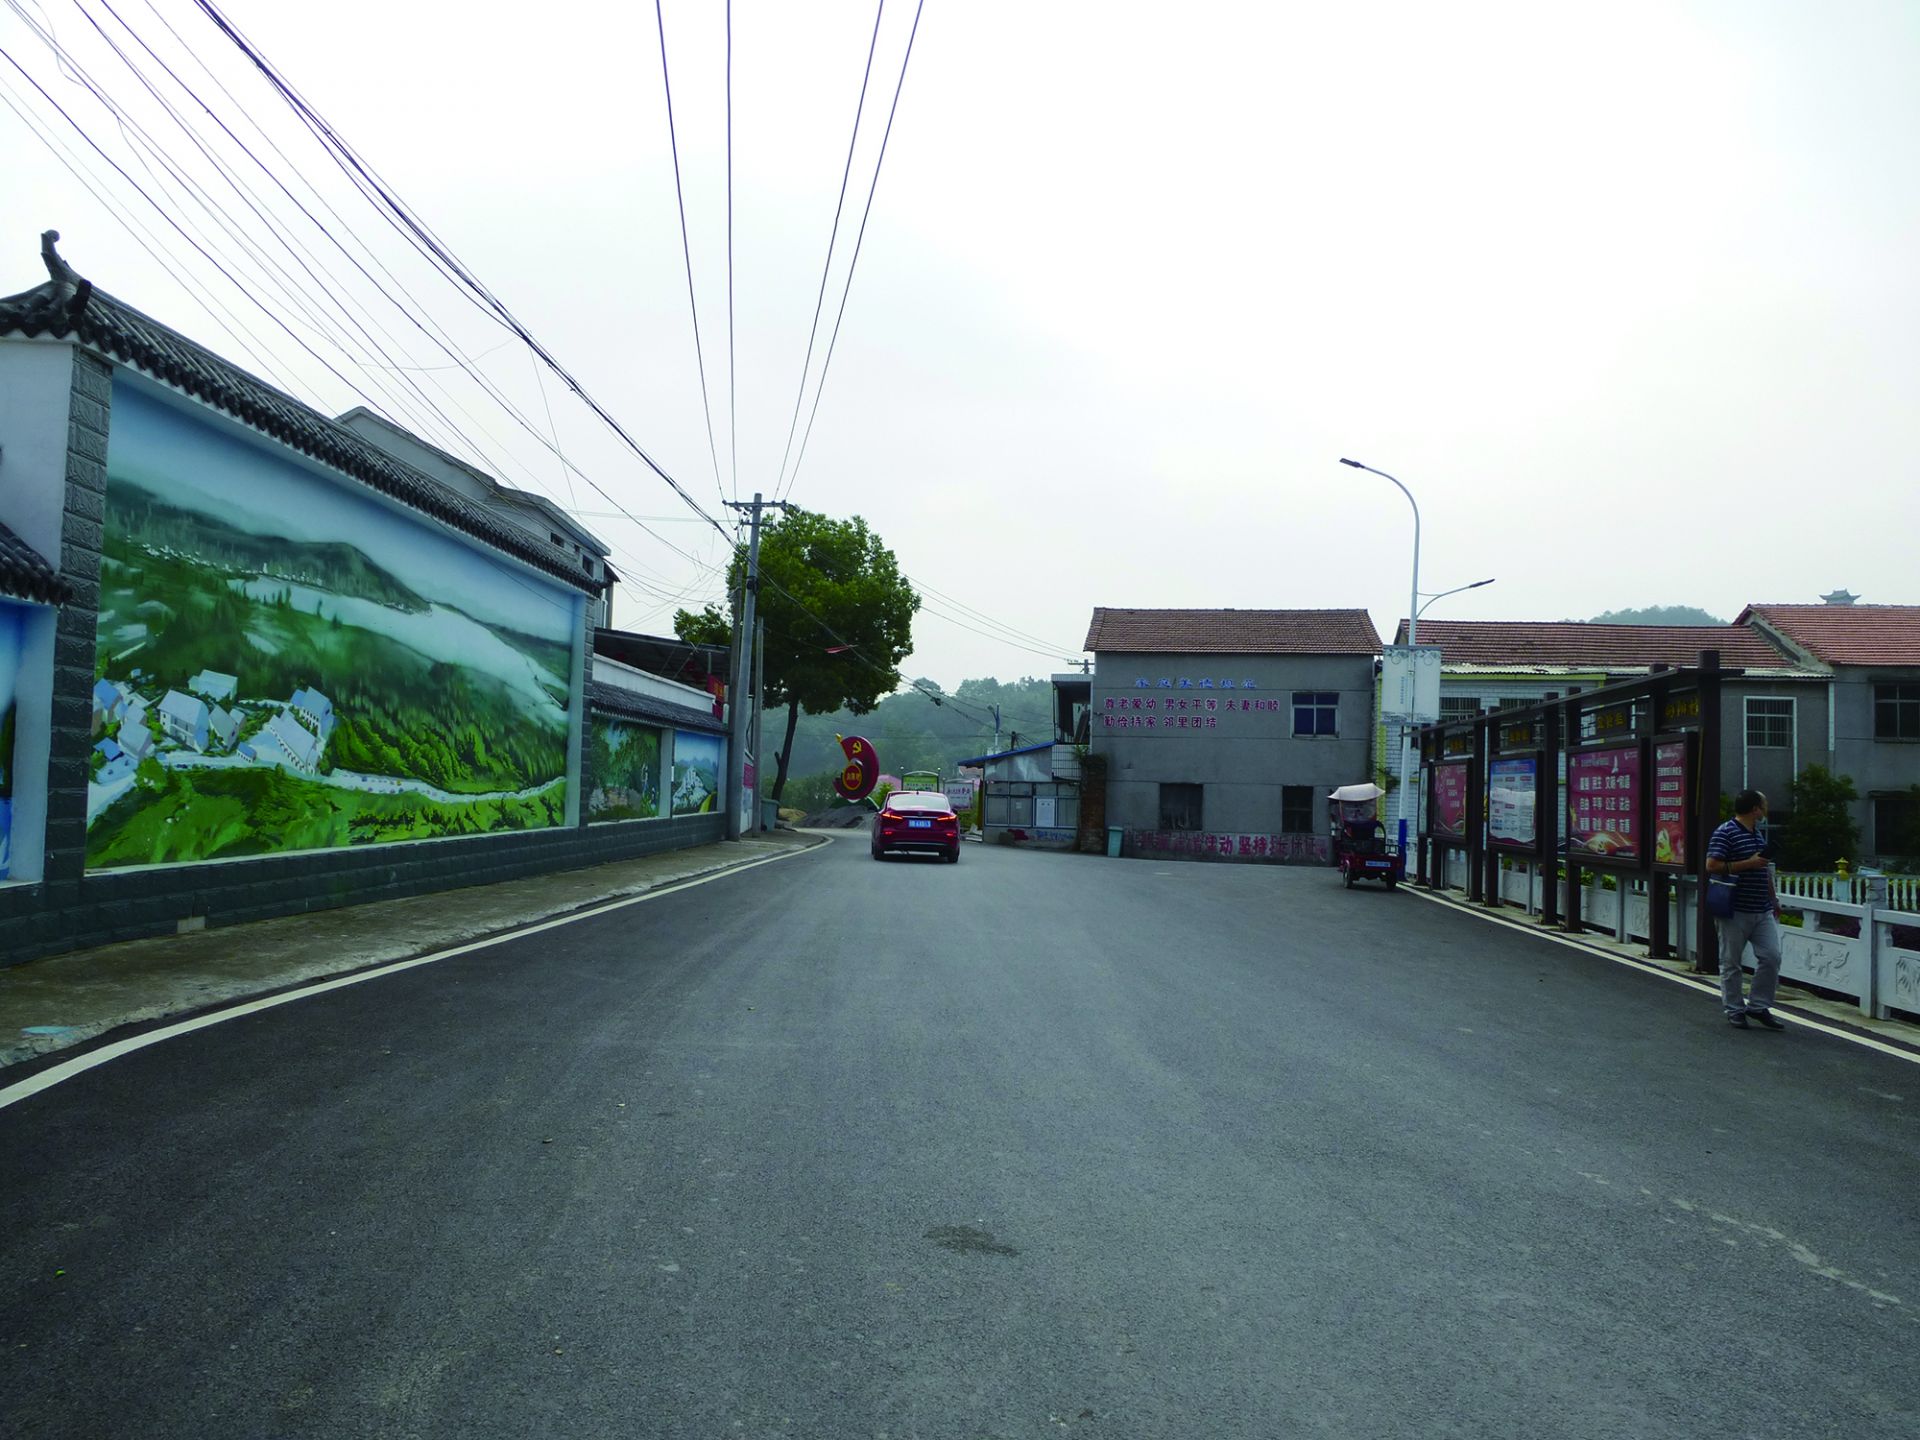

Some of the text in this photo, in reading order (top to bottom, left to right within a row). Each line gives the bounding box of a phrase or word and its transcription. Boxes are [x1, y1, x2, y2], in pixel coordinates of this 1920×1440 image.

[1104, 697, 1280, 712] 尊老爱幼 男女平等 夫妻和睦
[1104, 715, 1217, 729] 勤俭持家 邻里团结
